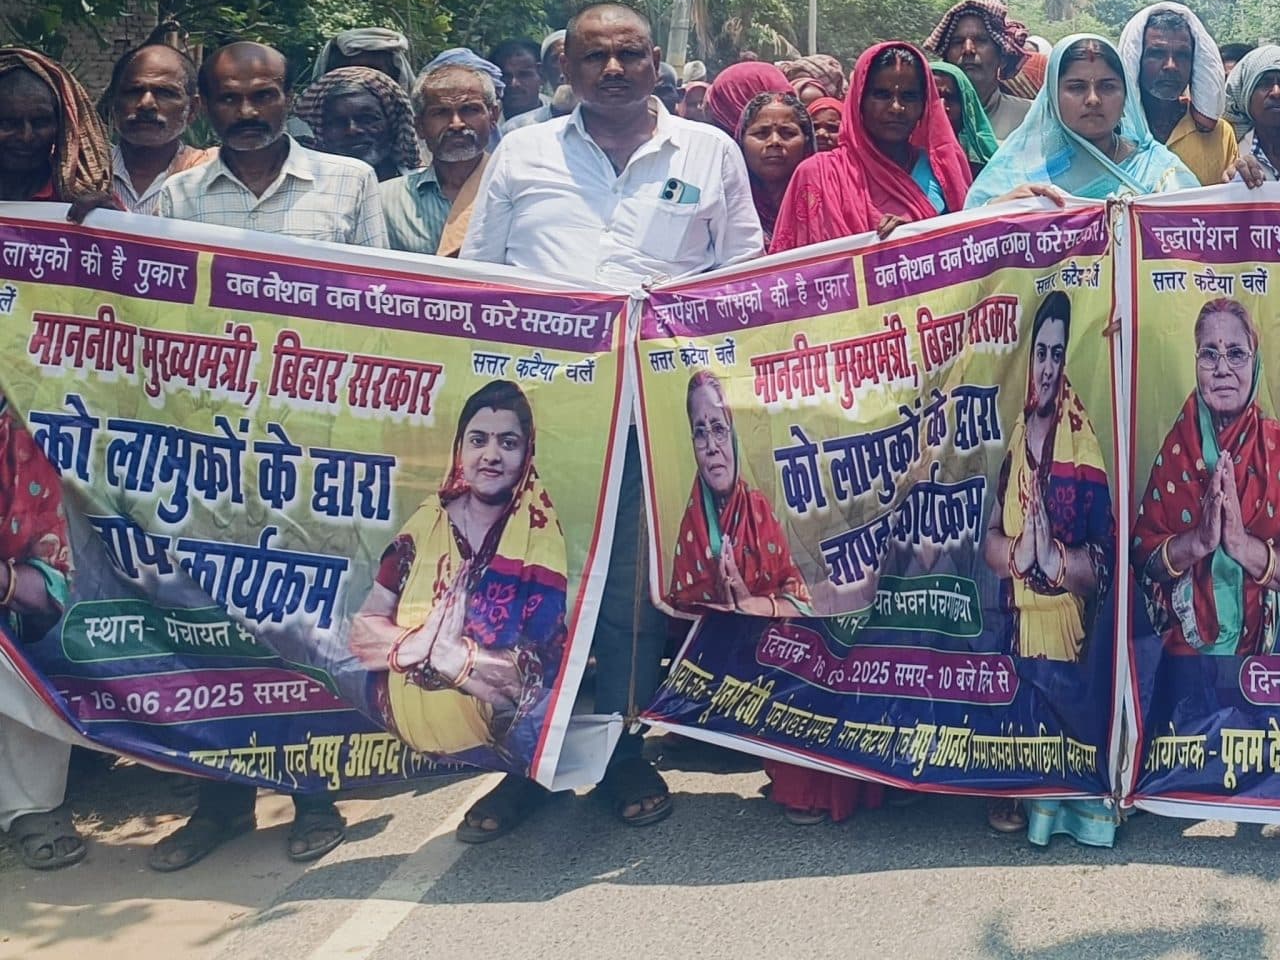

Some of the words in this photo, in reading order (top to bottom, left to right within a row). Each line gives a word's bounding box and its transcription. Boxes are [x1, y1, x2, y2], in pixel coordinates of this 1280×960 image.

[874, 262, 898, 289] वन
[898, 253, 936, 283] नेशन
[938, 246, 962, 273] वन
[962, 234, 1000, 266] पेंशन
[998, 232, 1036, 263] लागू
[1036, 223, 1062, 254] करे
[1151, 218, 1239, 253] वृद्धापेंशन
[1, 238, 71, 278] लाभुको
[81, 243, 102, 277] की
[111, 245, 127, 281] है
[135, 258, 190, 294] पुकार
[1152, 271, 1187, 291] सत्तर
[1194, 269, 1233, 294] कटैया
[1242, 269, 1268, 294] चलें
[226, 271, 260, 299] वन
[262, 271, 319, 307] नेशन
[326, 287, 361, 311] वन
[423, 297, 477, 334] लागू
[481, 299, 520, 329] करे
[716, 283, 763, 325] लाभुको
[770, 278, 790, 308] की
[795, 273, 808, 305] है
[814, 273, 851, 310] पुकार
[28, 305, 137, 375] माननीय
[269, 330, 348, 404] बिहार
[348, 355, 443, 416] सरकार
[473, 352, 508, 376] सत्तर
[515, 352, 560, 381] कटैया
[565, 359, 596, 383] चलें
[649, 349, 675, 372] सत्तर
[679, 341, 709, 368] कटैया
[715, 338, 736, 365] चलें
[750, 333, 831, 404] माननीय
[917, 307, 965, 372] बिहार
[967, 296, 1019, 345] सरकार
[30, 395, 99, 482] को
[107, 416, 249, 524] लाभुकों
[254, 423, 302, 509] के
[310, 448, 397, 521] द्वारा
[774, 425, 827, 513] को
[822, 397, 922, 505] लाभुकों
[923, 388, 948, 446] के
[951, 385, 1002, 450] द्वारा
[894, 462, 987, 544] कार्यक्रम
[175, 527, 349, 629] कार्यक्रम
[894, 589, 928, 616] भवन
[164, 612, 230, 647] पंचायत
[938, 666, 952, 689] 10
[956, 660, 977, 691] बजे
[996, 662, 1009, 693] से
[1220, 728, 1265, 789] पूनम
